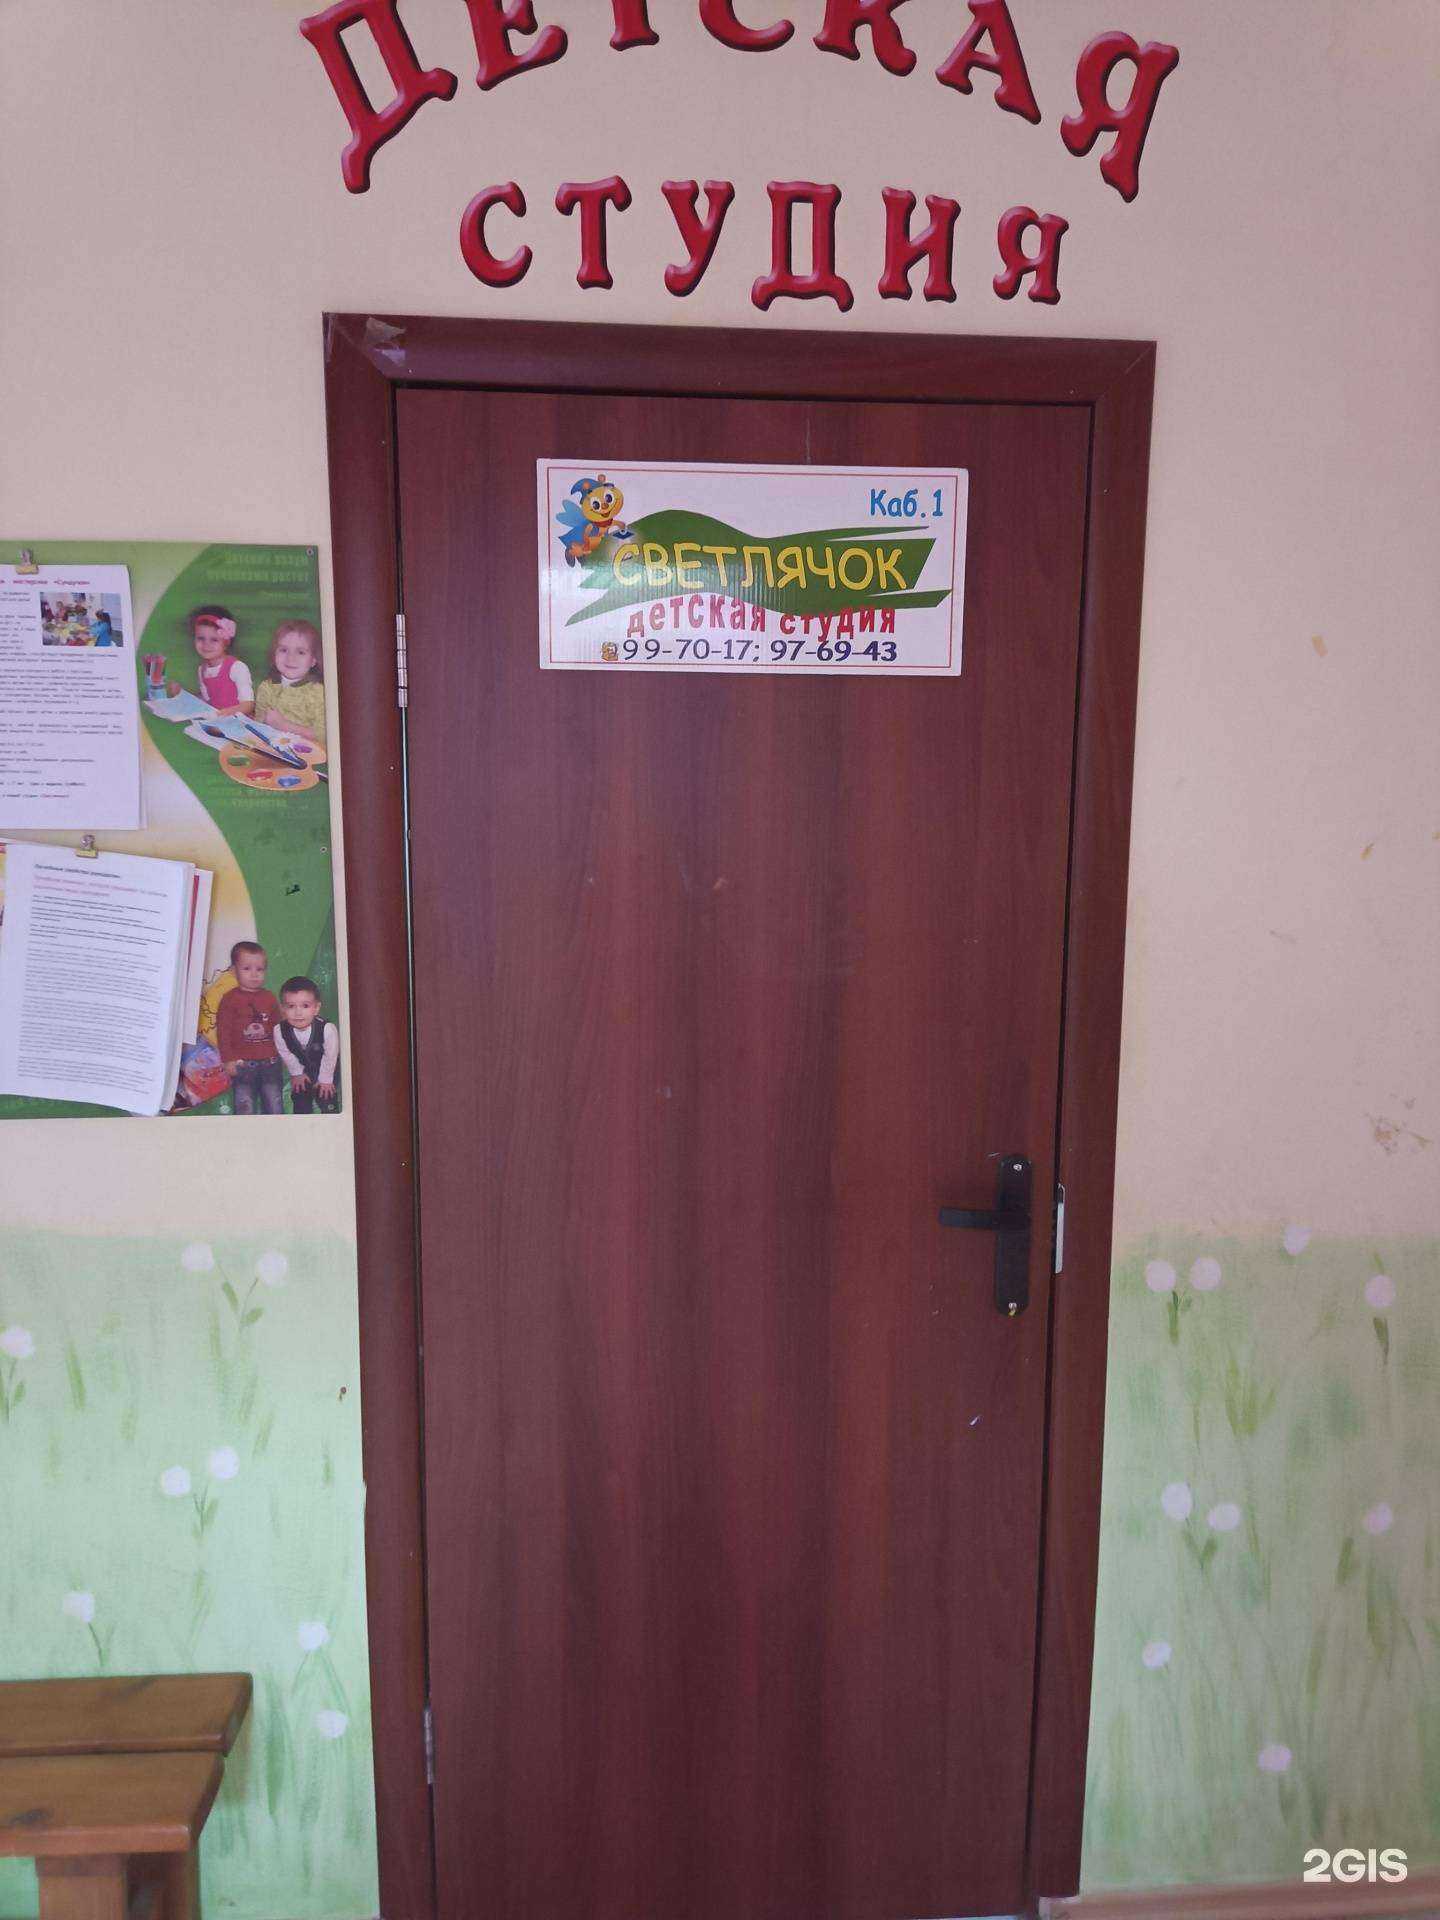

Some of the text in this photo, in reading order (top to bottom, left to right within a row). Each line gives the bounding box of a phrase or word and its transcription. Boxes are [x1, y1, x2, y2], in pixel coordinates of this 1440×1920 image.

[459, 175, 1070, 313] СТУДИЯ
[612, 542, 907, 591] СВЕТЛЯЧОК
[626, 594, 896, 642] детская студия
[770, 640, 897, 662] 97-69-43
